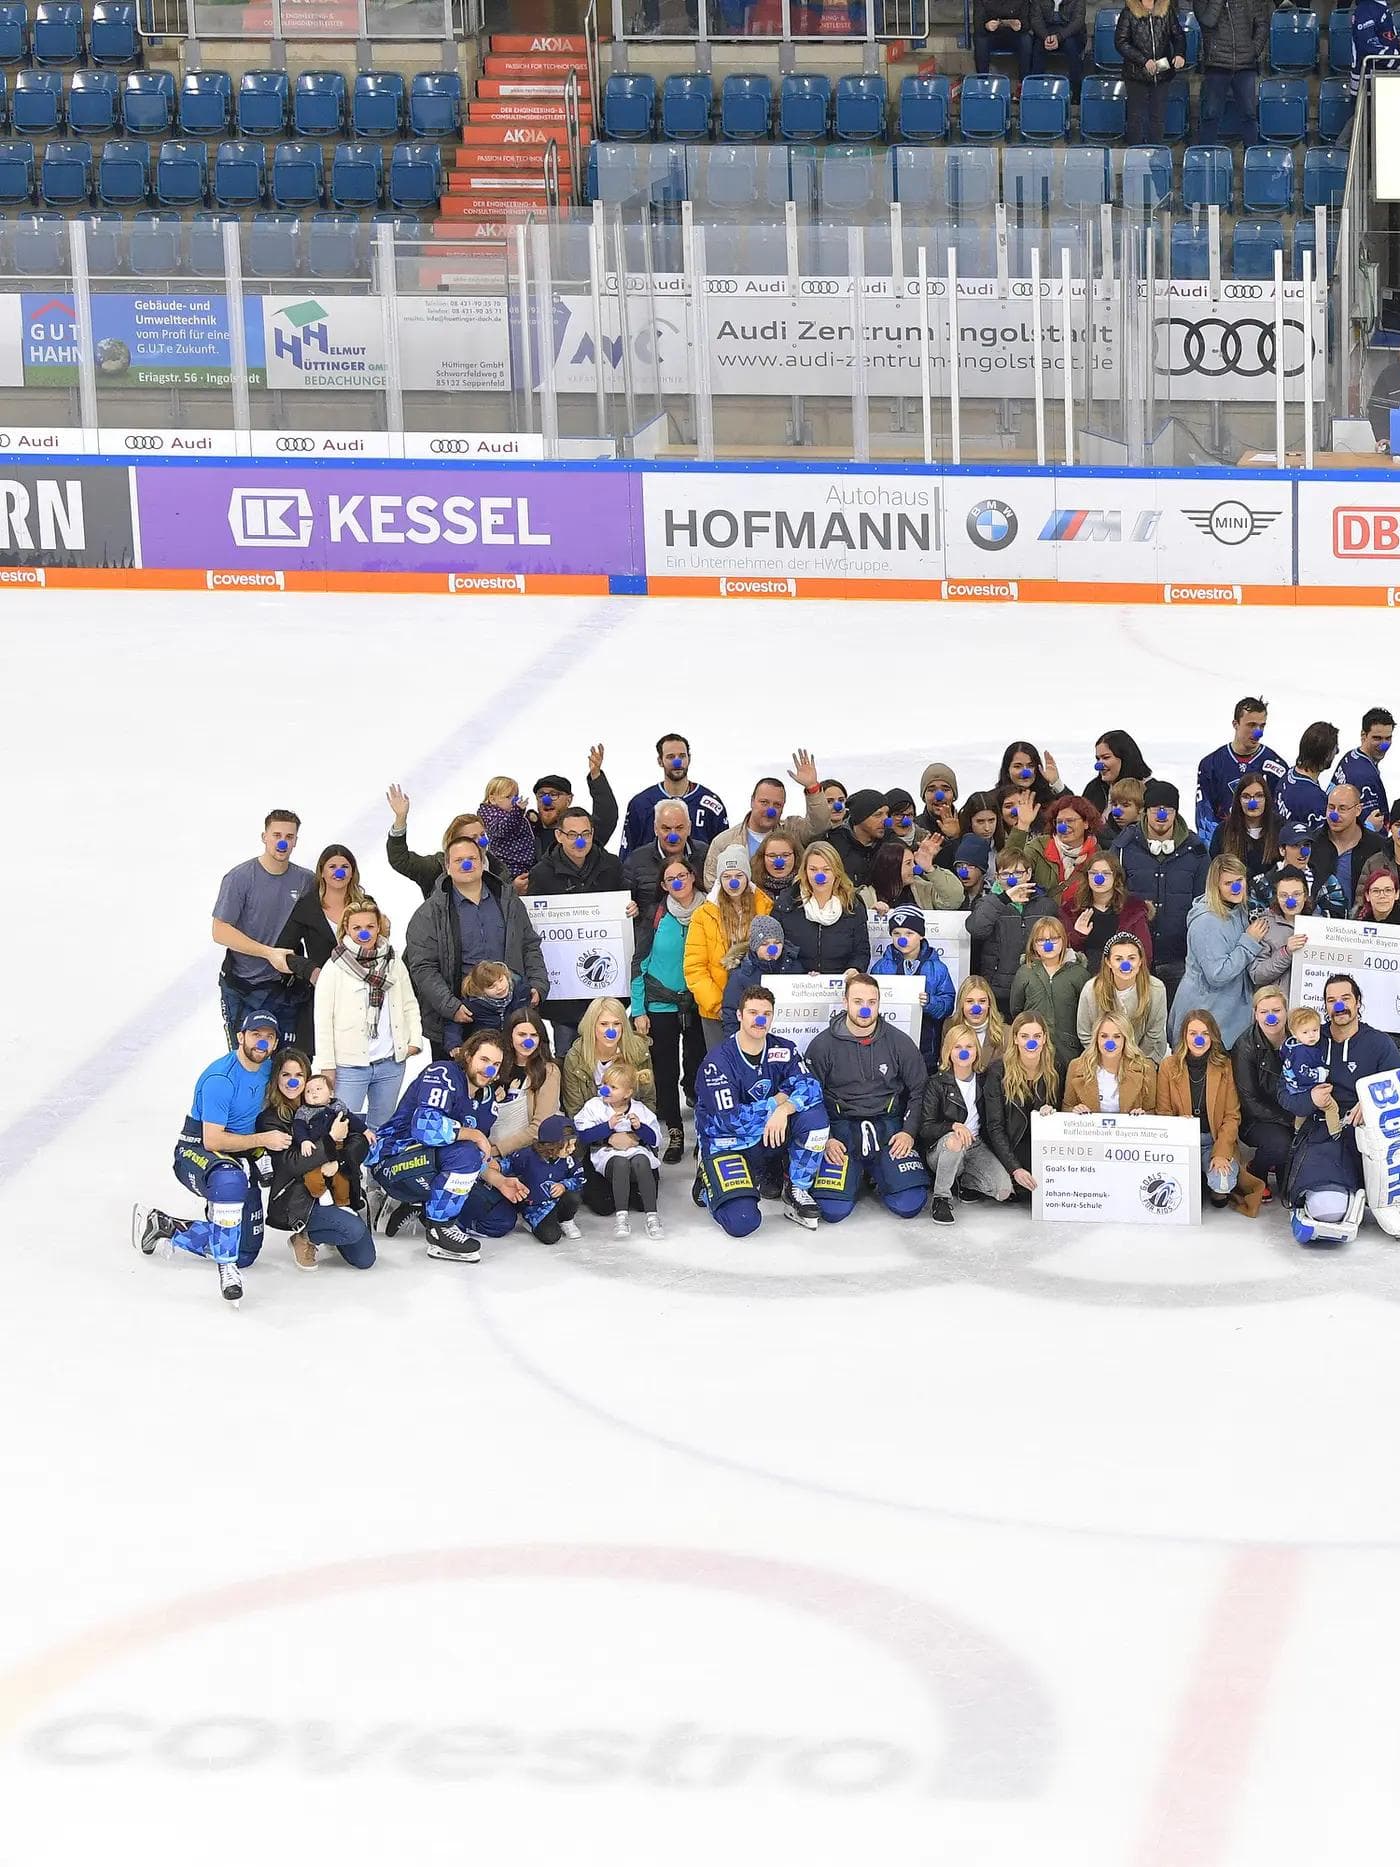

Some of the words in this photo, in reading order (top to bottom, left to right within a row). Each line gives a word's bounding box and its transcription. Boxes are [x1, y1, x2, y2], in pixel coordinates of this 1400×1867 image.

[503, 128, 546, 143] AKKA
[745, 281, 786, 293] Audi
[135, 299, 187, 311] Gebäude-
[189, 300, 210, 311] und
[135, 315, 217, 326] Umwelttechnik
[136, 331, 159, 340] vom
[162, 328, 186, 340] Profi
[189, 328, 205, 340] für
[717, 321, 787, 341] Audi
[175, 343, 220, 355] Zukunft.
[138, 372, 181, 385] Eriagstr.
[184, 373, 198, 383] 56
[18, 435, 59, 448] Audi
[171, 436, 213, 450] Audi
[323, 438, 365, 452] Audi
[476, 440, 519, 454] Audi
[825, 484, 929, 506] Autohaus
[328, 494, 552, 546] KESSEL
[1215, 517, 1248, 530] MINI
[664, 509, 929, 551] HOFMANN
[1341, 515, 1400, 551] DB
[666, 556, 687, 569] Ein
[690, 556, 784, 571] Unternehmen
[787, 556, 812, 571] der
[814, 559, 894, 575] HWGruppe.
[212, 571, 277, 587] covestro
[454, 576, 516, 591] covestro
[726, 580, 788, 595] covestro
[948, 584, 1010, 597] covestro
[1171, 587, 1233, 601] covestro
[696, 809, 705, 827] C
[577, 928, 608, 940] Euro
[1303, 950, 1353, 963] SPENDE
[428, 1088, 449, 1109] 81
[715, 1088, 734, 1111] 16
[1042, 1146, 1093, 1156] SPENDE
[1144, 1150, 1175, 1163] Euro
[1045, 1165, 1066, 1173] Goals
[1067, 1165, 1078, 1173] for
[1080, 1165, 1096, 1173] Kids
[725, 1180, 751, 1188] EDEKA
[816, 1179, 842, 1187] EDEKA
[21, 1708, 916, 1794] covestro
